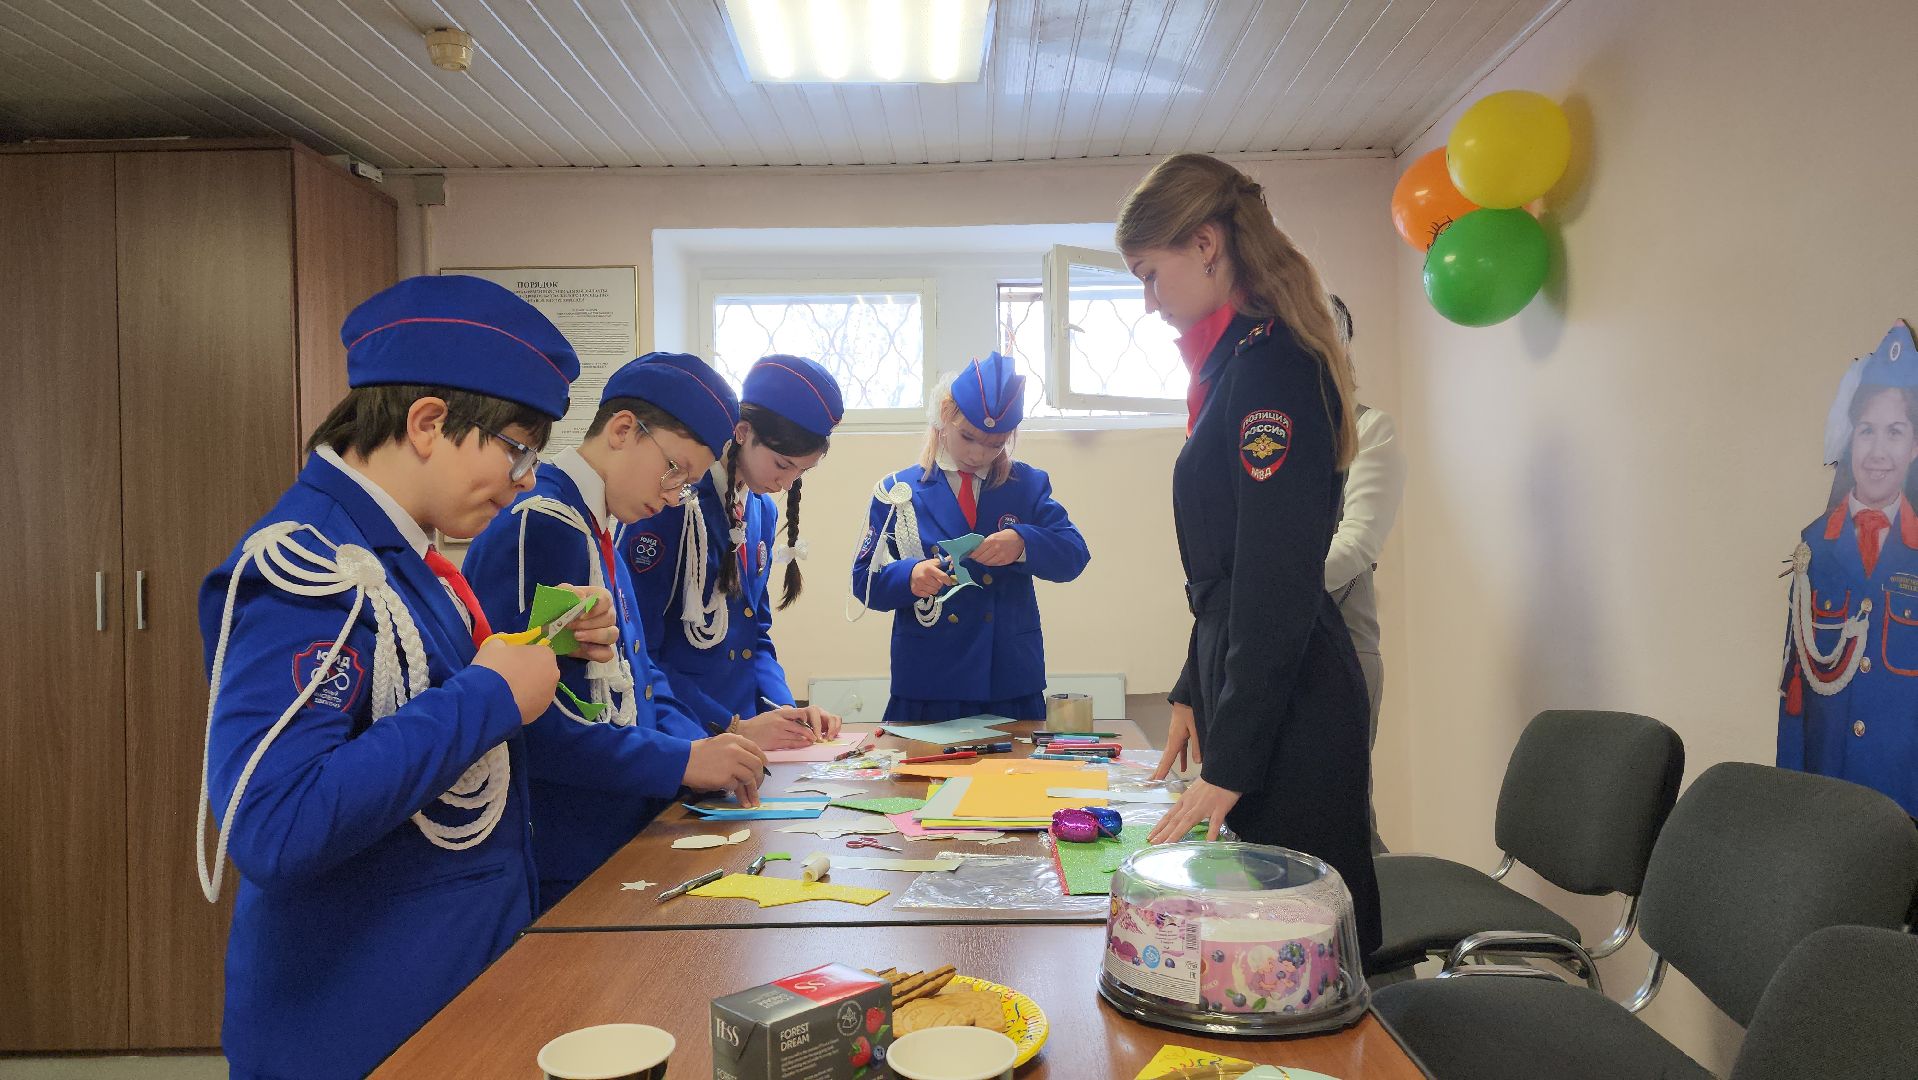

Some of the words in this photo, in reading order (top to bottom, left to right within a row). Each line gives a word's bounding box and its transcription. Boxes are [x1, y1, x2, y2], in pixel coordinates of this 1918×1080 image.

[517, 281, 558, 289] ПОРЯДОК
[1242, 412, 1289, 429] ПОЛИЦИЯ
[1244, 424, 1286, 440] РОССИЯ
[1251, 467, 1272, 479] МВД
[714, 1017, 740, 1047] TESS
[780, 1022, 810, 1041] FOREST
[780, 1033, 811, 1052] DREAM
